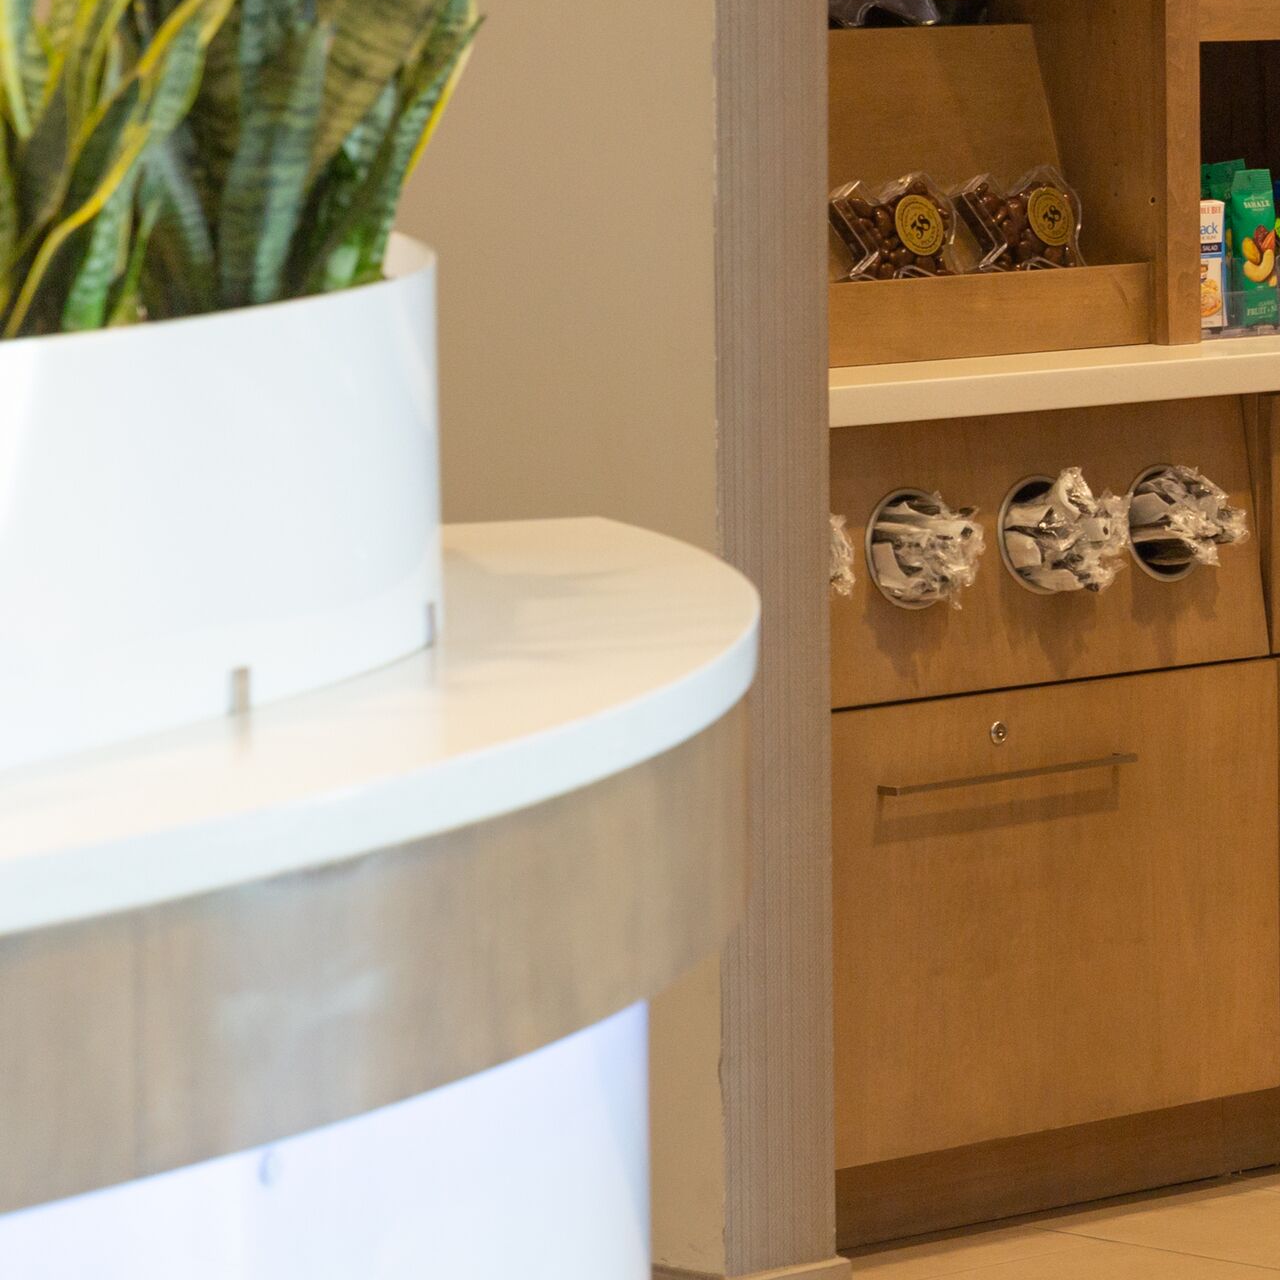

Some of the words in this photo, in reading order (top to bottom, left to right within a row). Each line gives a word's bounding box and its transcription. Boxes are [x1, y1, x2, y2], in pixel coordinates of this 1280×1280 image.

[910, 214, 931, 239] 38
[1042, 205, 1062, 231] 38
[1200, 222, 1218, 235] ack
